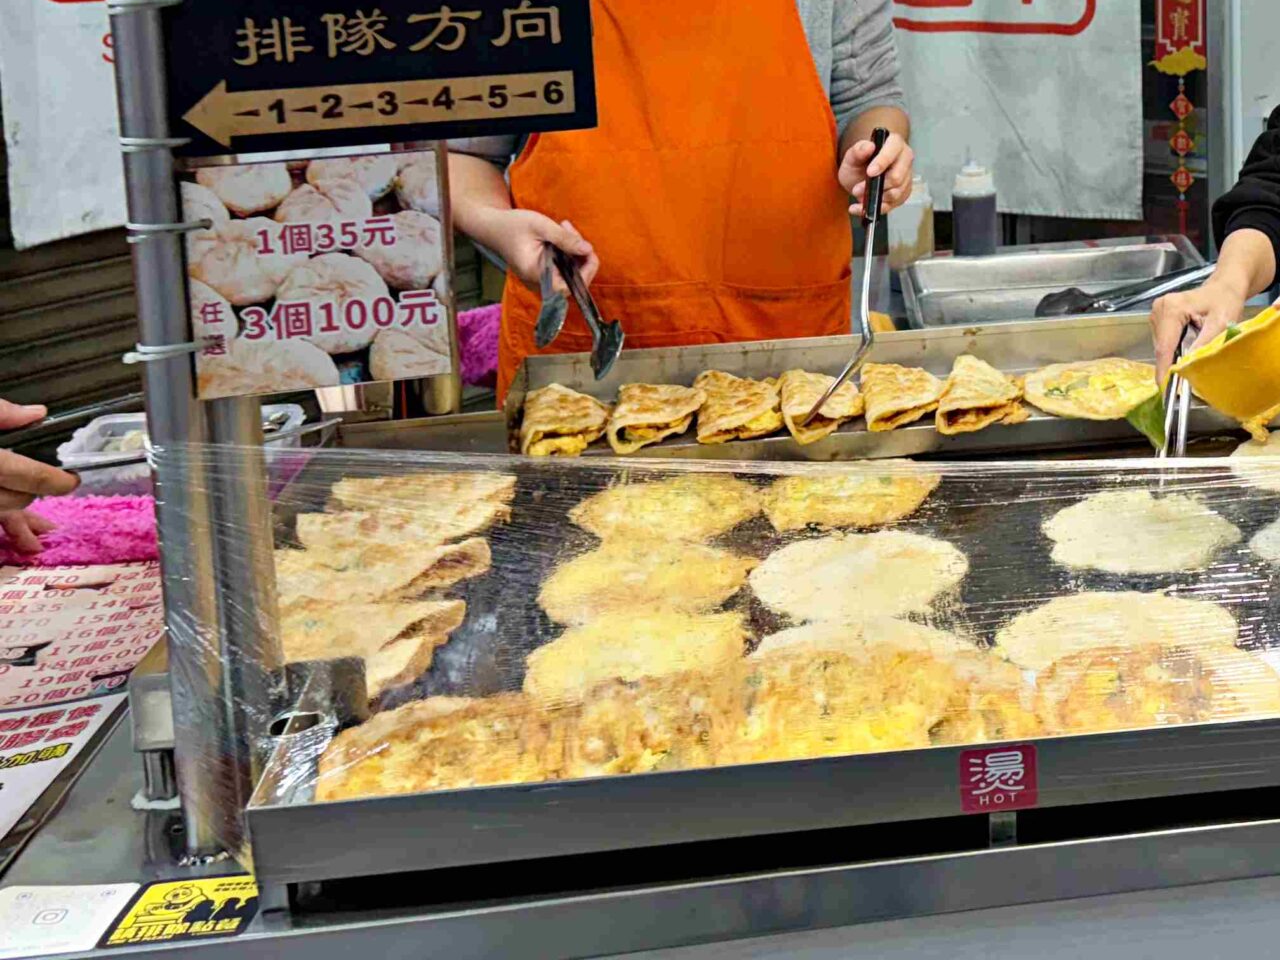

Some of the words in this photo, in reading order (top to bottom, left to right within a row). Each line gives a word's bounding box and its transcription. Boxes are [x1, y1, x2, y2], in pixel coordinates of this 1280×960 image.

[257, 218, 396, 255] 1個35元
[243, 292, 438, 340] 3個100元
[969, 750, 1025, 795] 燙
[979, 792, 1017, 805] HOT
